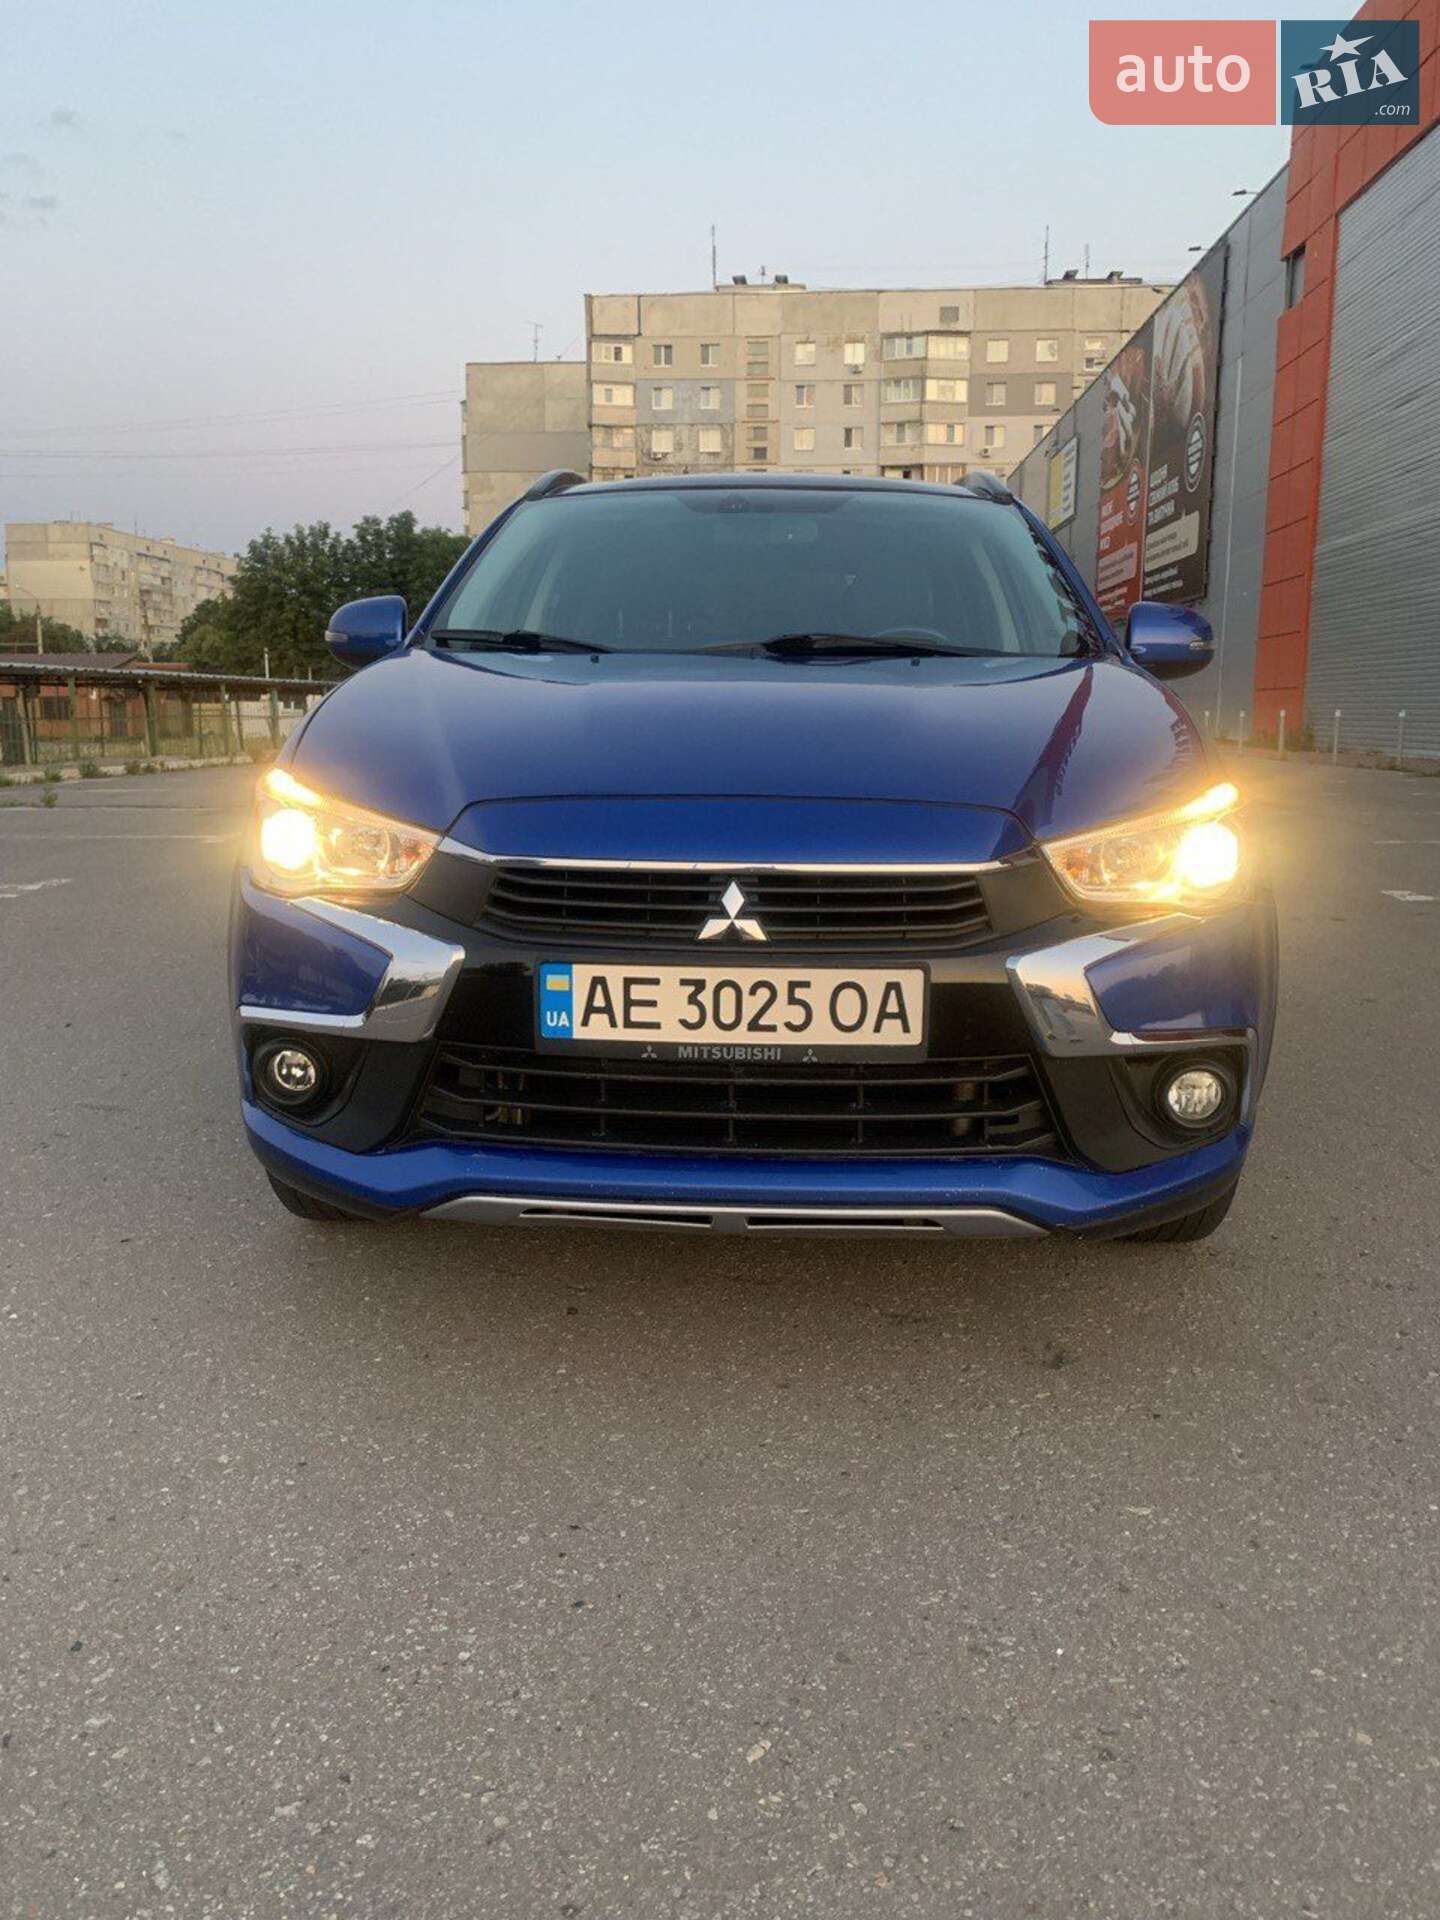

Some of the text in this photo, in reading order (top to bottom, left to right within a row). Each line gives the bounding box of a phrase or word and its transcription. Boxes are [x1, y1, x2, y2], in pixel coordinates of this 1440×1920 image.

[580, 975, 911, 1034] AE 3025 OA
[546, 1010, 570, 1029] UA
[678, 1045, 781, 1061] MITSUBISHI
